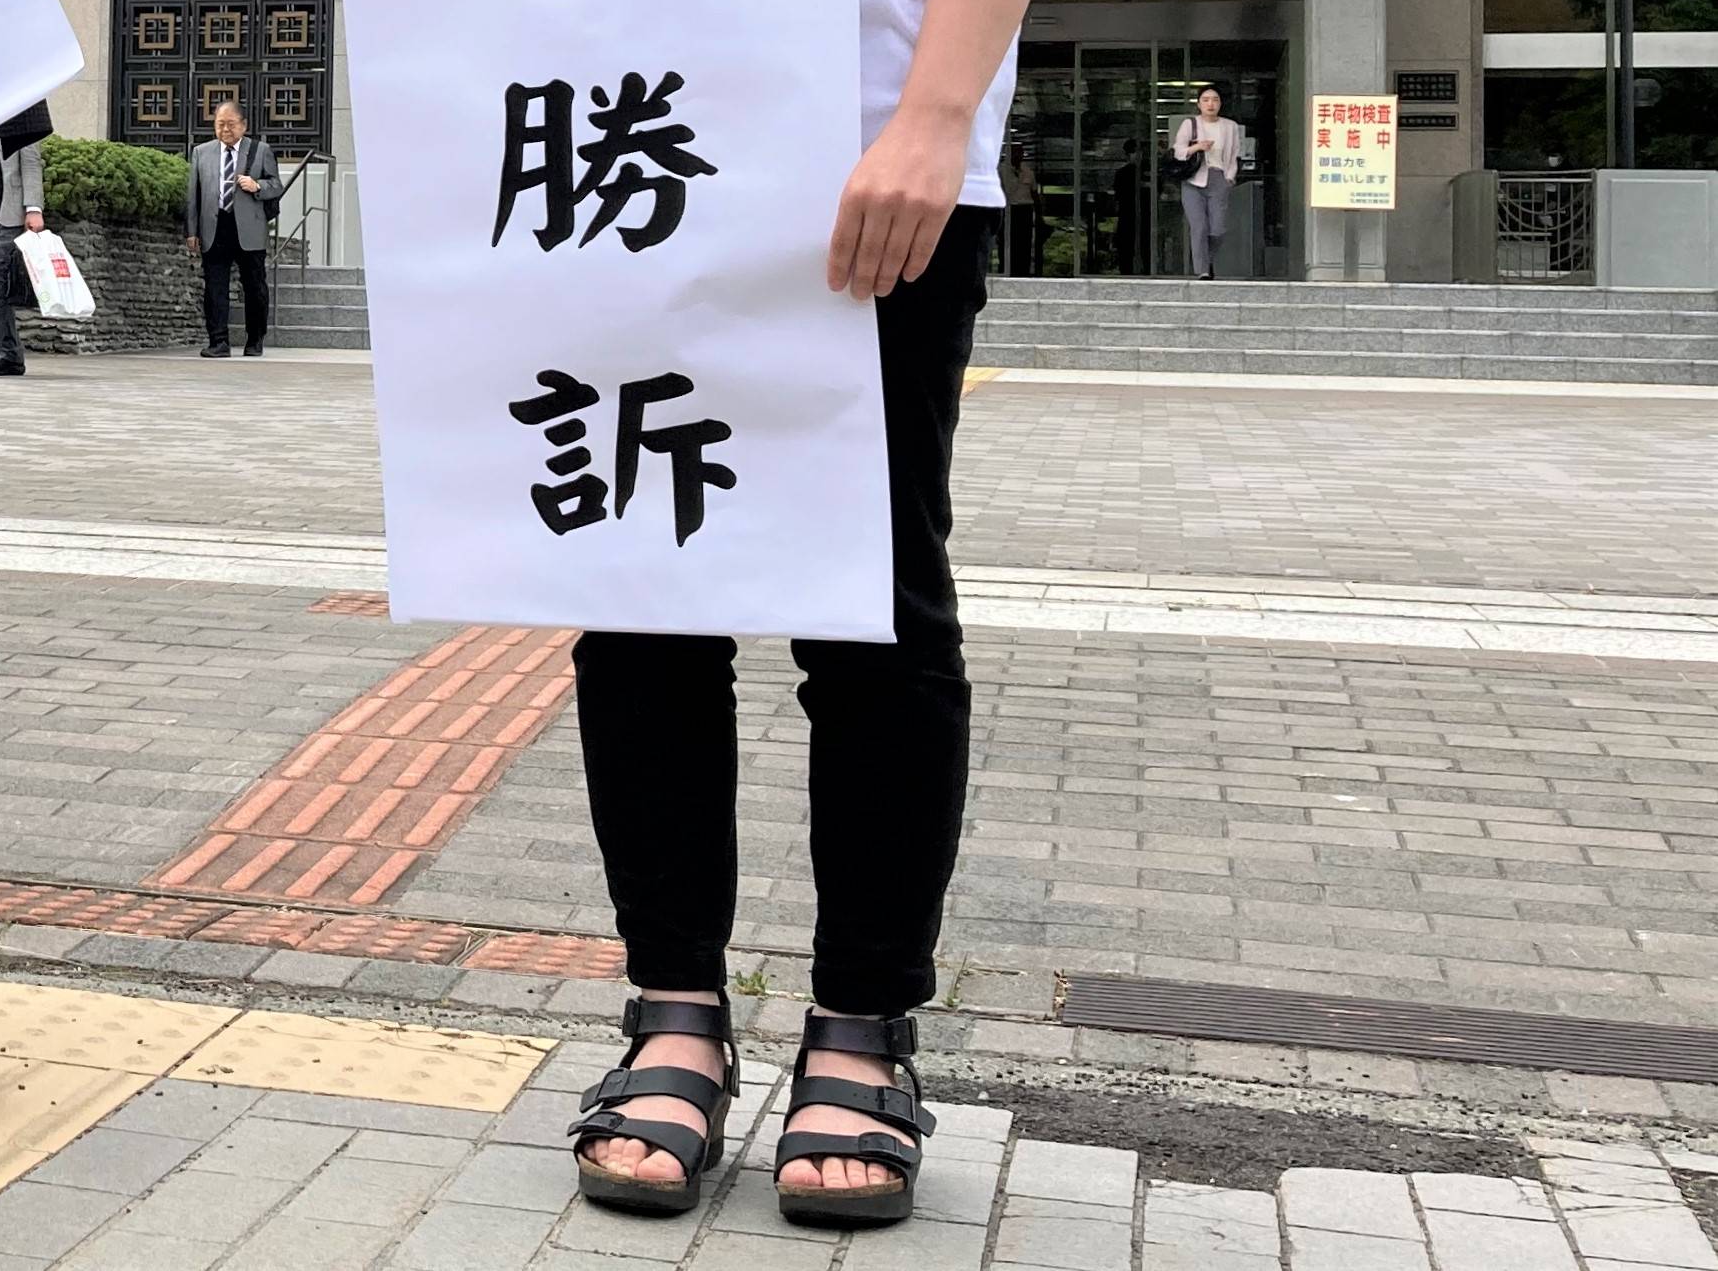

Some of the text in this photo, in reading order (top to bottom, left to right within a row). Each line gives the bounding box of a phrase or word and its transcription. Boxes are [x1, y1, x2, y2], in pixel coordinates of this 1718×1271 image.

[1317, 103, 1391, 124] 手荷物検査
[1319, 157, 1365, 167] 御協力を
[1319, 174, 1388, 184] お願いします
